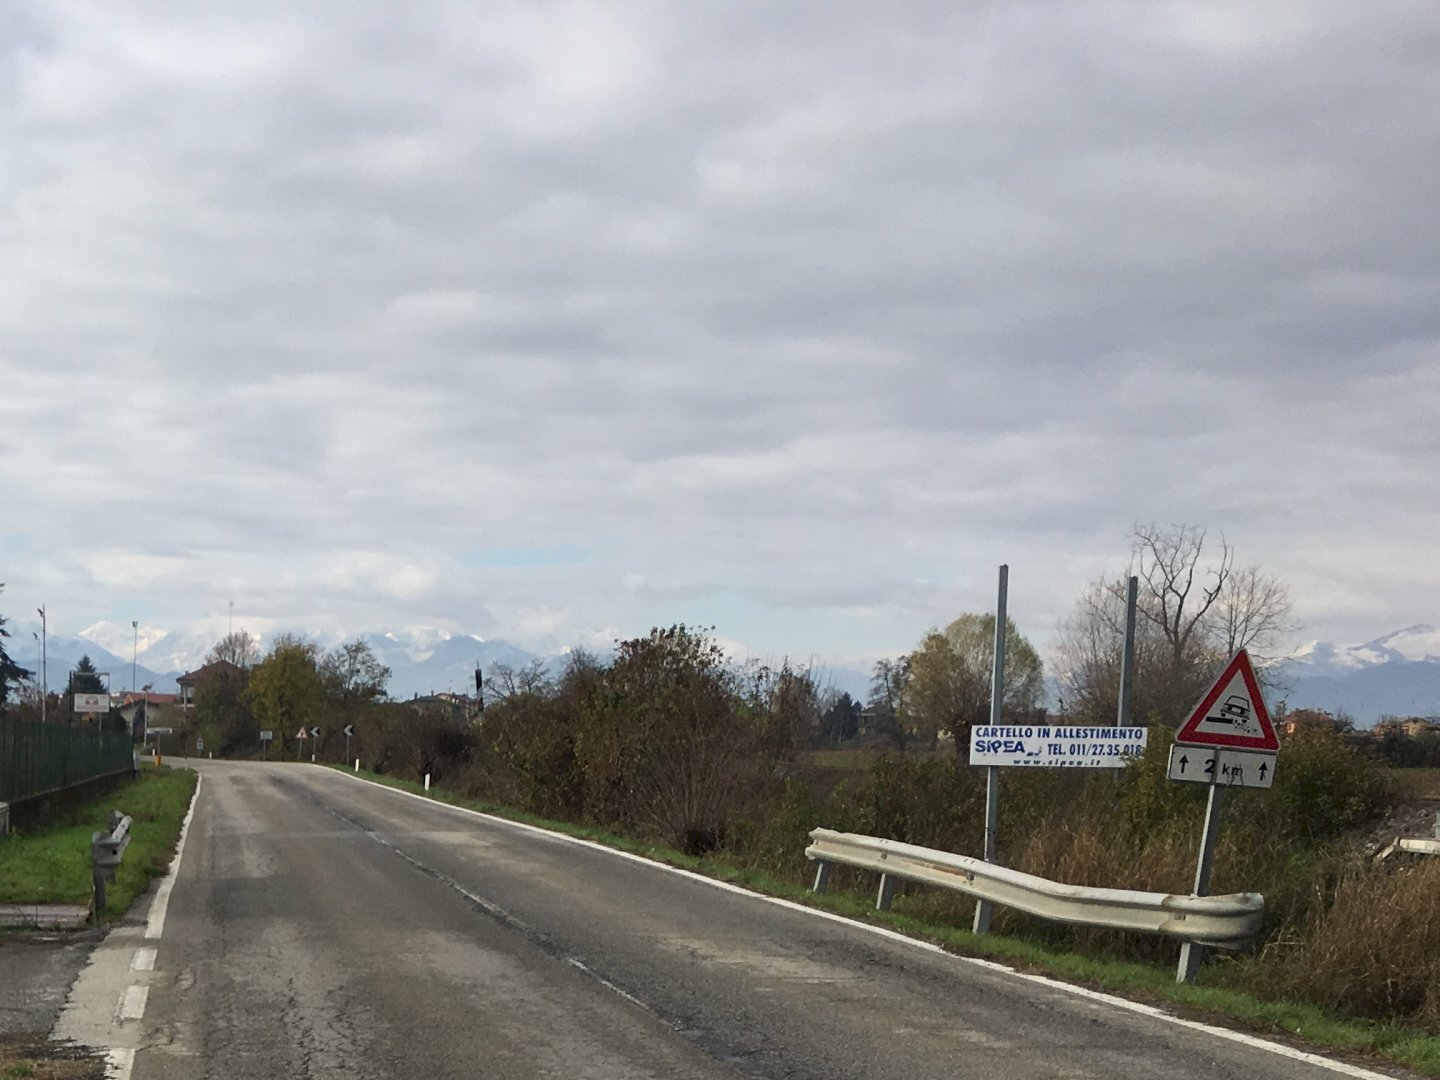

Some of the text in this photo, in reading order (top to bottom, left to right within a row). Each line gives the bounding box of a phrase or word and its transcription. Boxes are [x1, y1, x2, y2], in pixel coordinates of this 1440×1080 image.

[976, 727, 1143, 740] CARTELLO IN ALLESTIMENTO
[975, 740, 1025, 753] SIPEA
[1047, 744, 1066, 756] TEL.
[1204, 759, 1243, 776] 2 km
